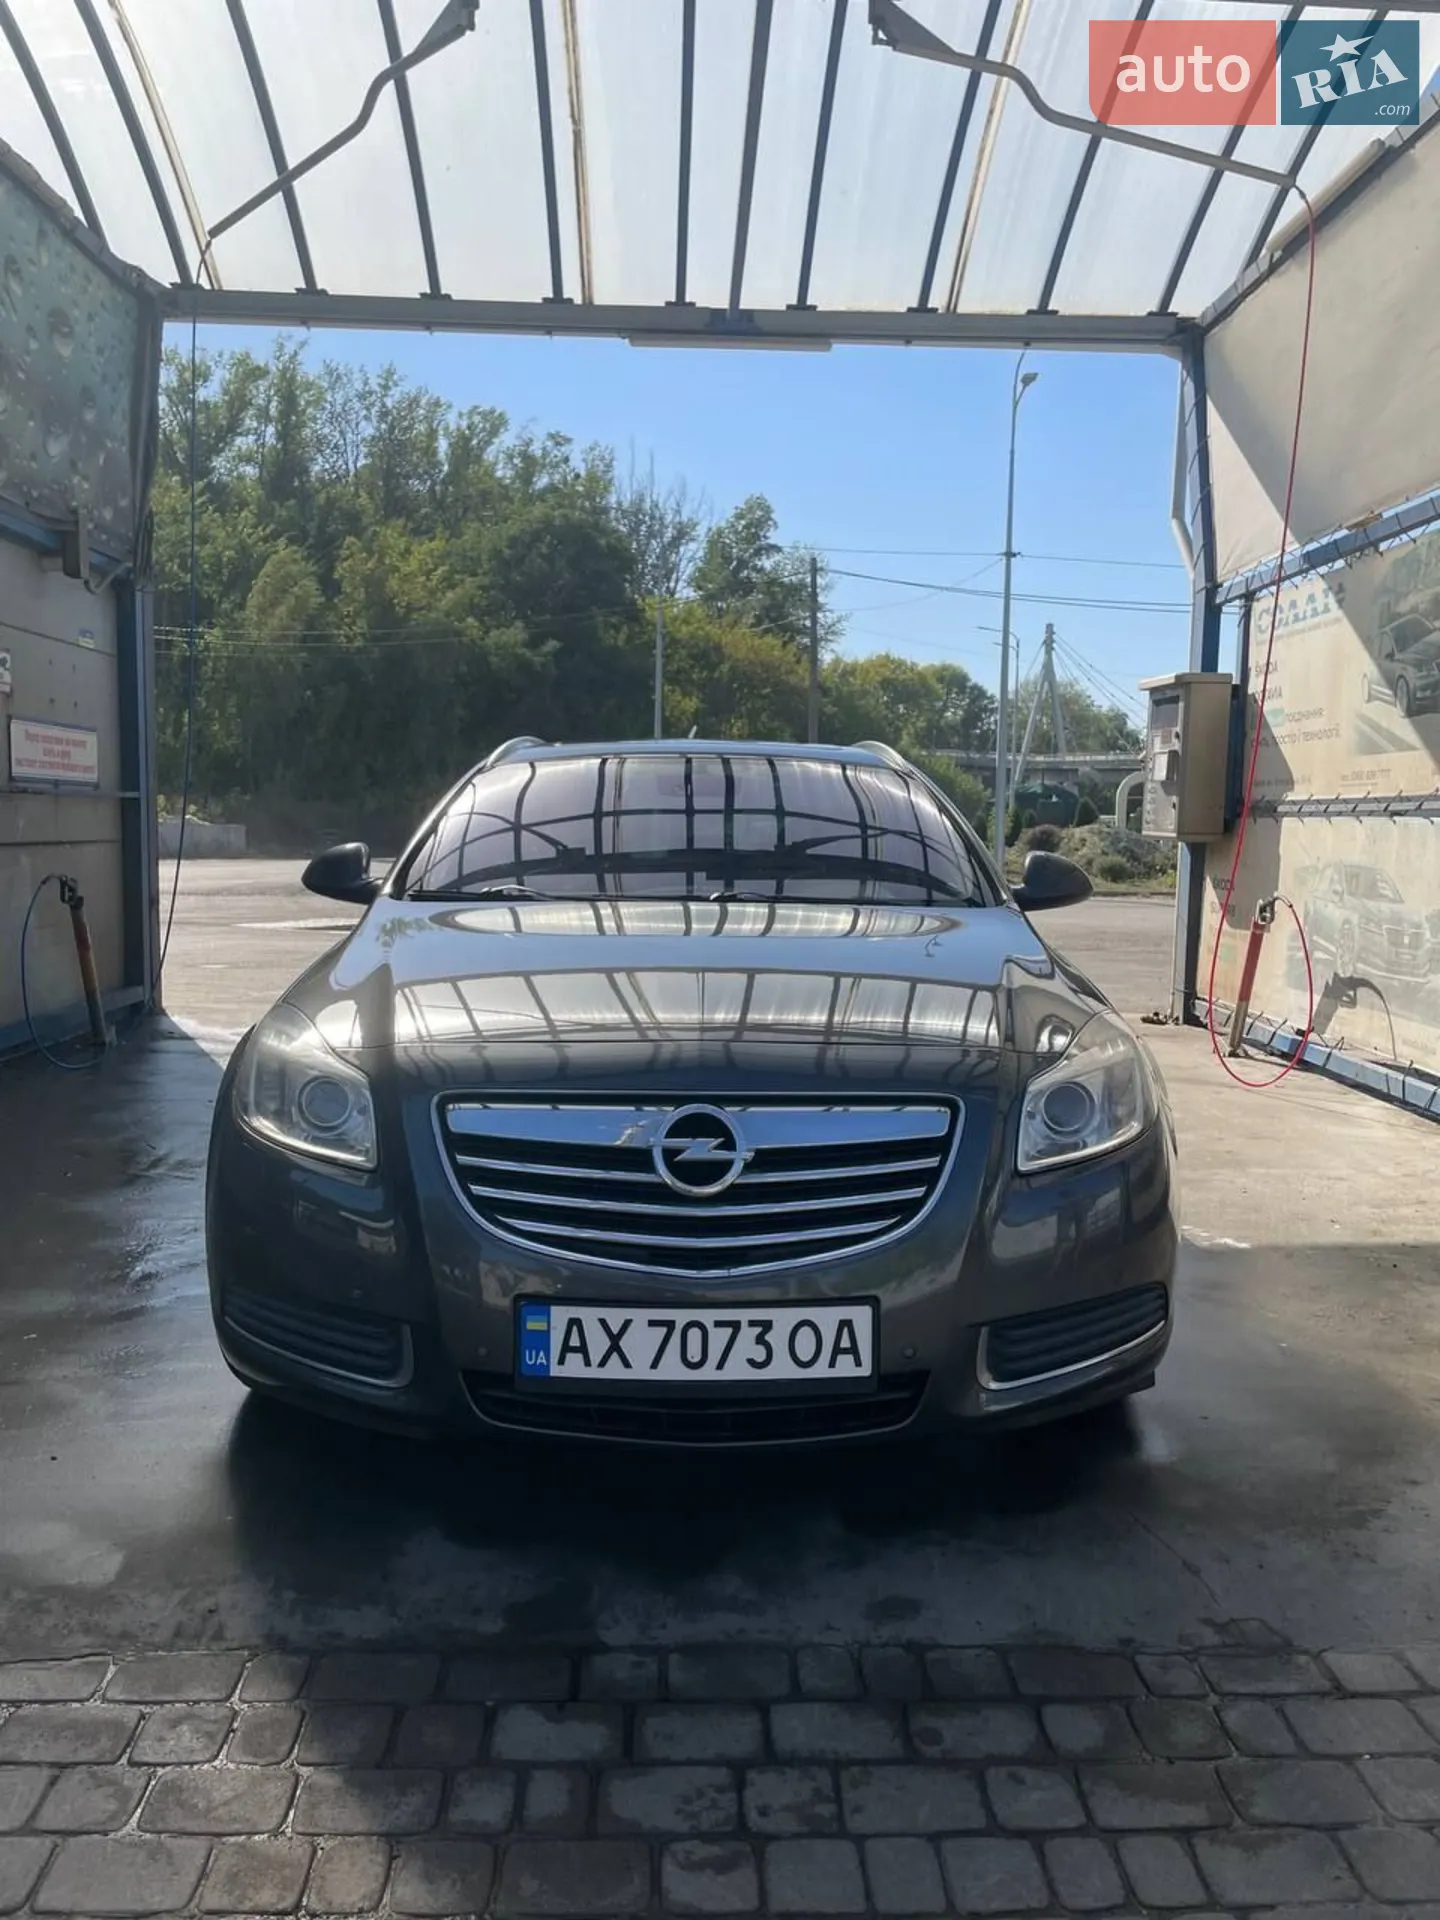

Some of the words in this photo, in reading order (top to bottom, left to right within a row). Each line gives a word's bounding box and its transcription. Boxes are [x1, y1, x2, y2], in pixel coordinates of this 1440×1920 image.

[525, 1350, 547, 1365] UA
[557, 1317, 633, 1369] AX
[648, 1319, 774, 1370] 7073
[788, 1319, 863, 1368] OA
